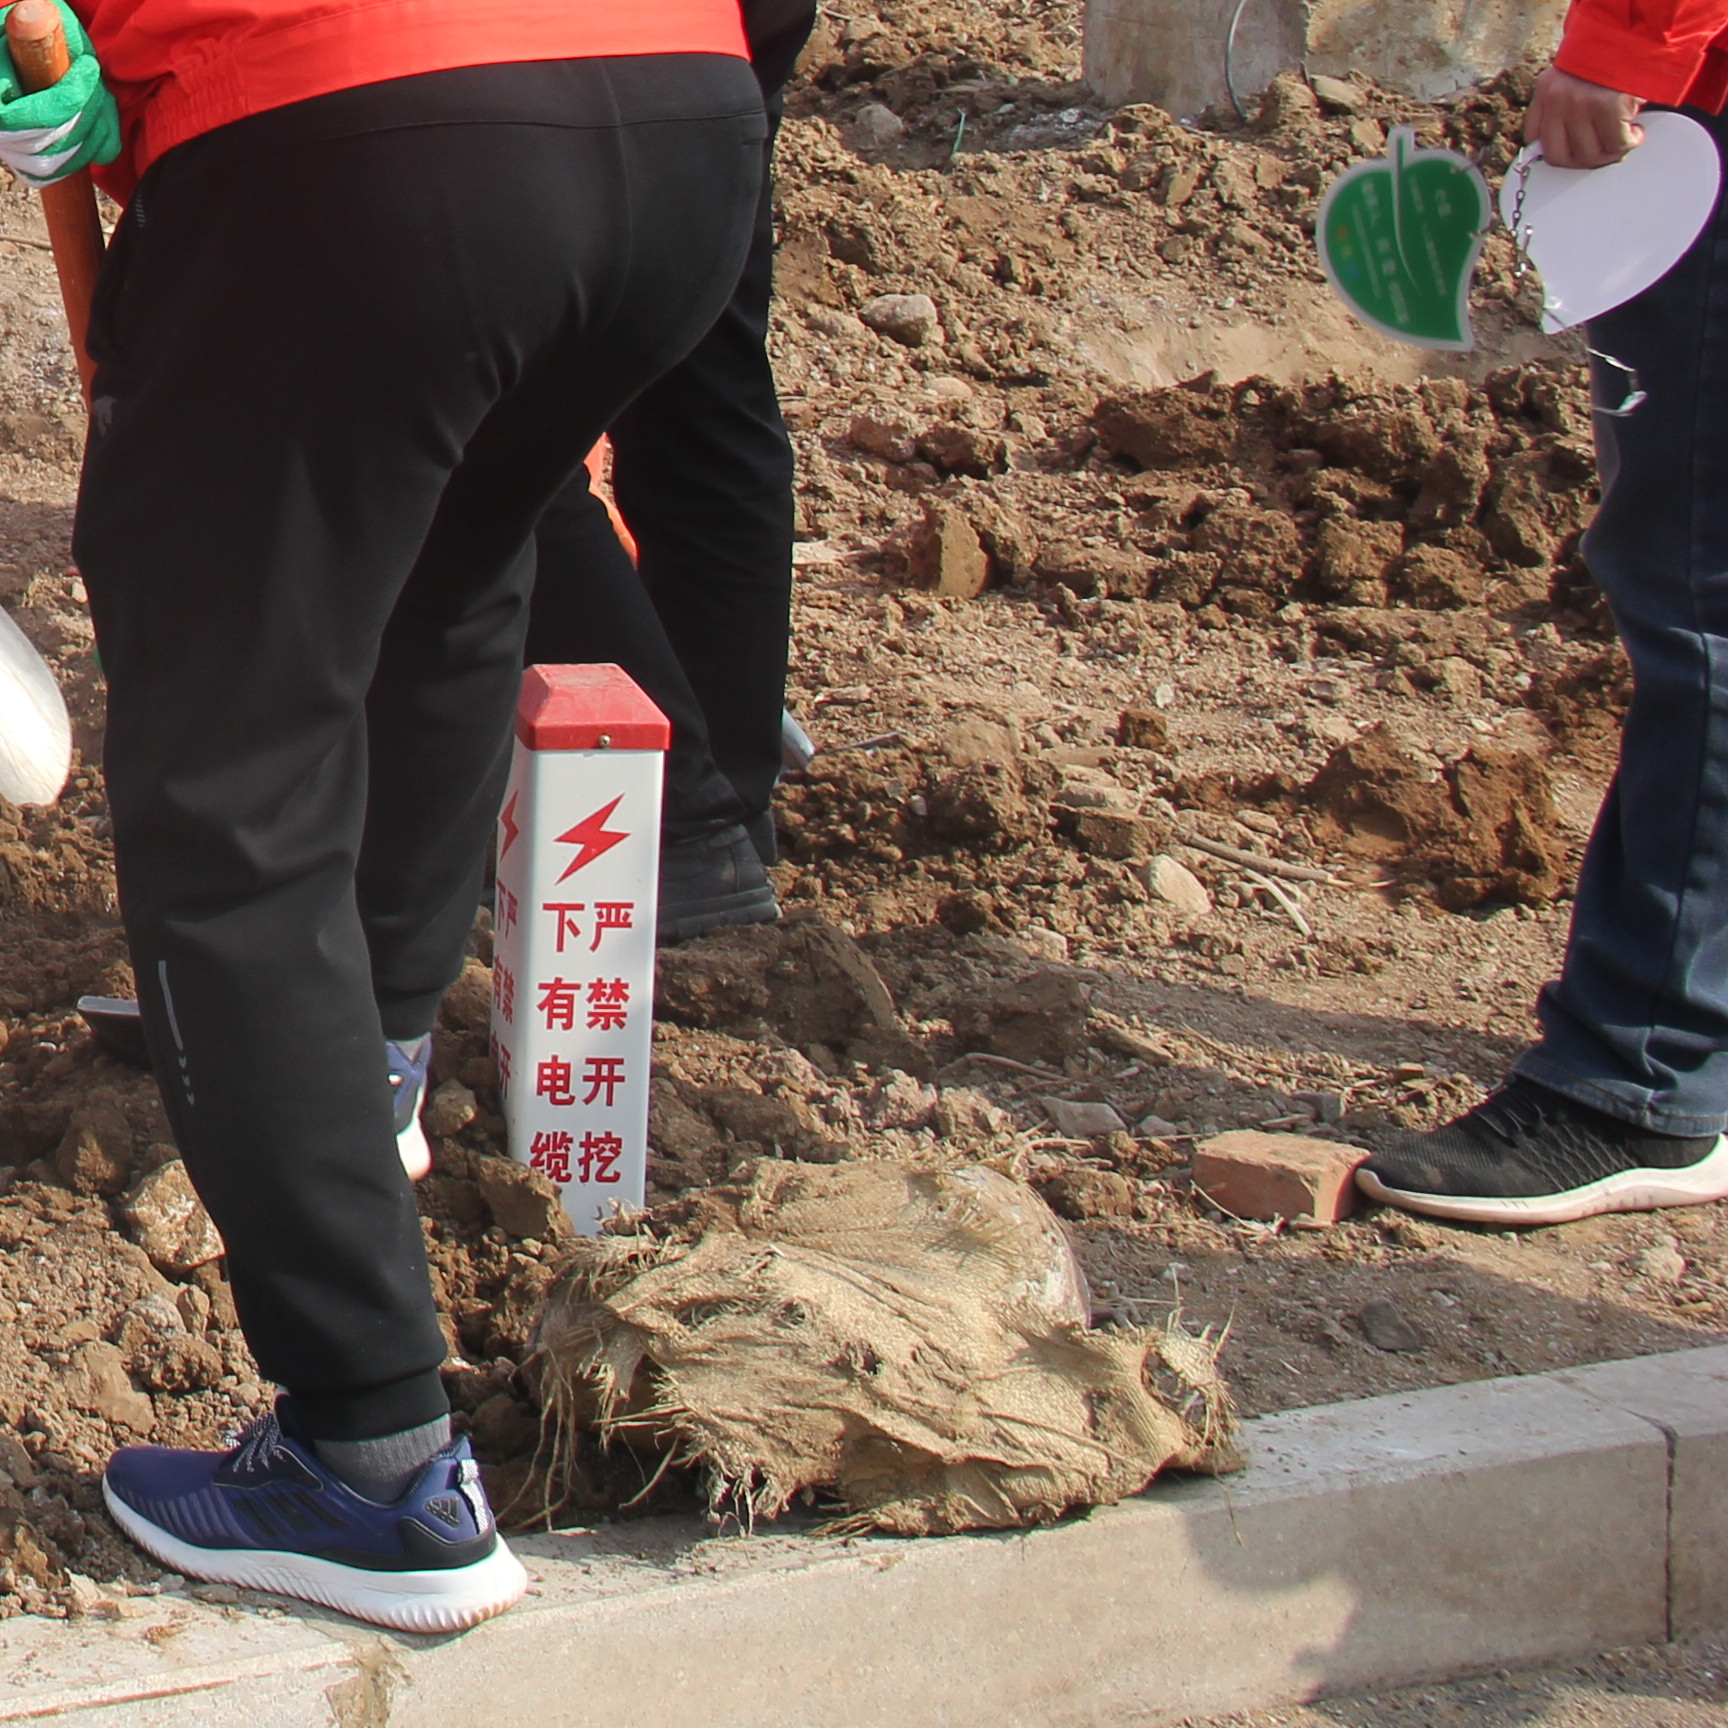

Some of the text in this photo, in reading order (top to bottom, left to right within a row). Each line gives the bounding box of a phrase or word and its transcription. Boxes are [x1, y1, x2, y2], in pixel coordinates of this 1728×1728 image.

[529, 902, 583, 1183] 下有电缆
[578, 901, 635, 1184] 严禁开挖
